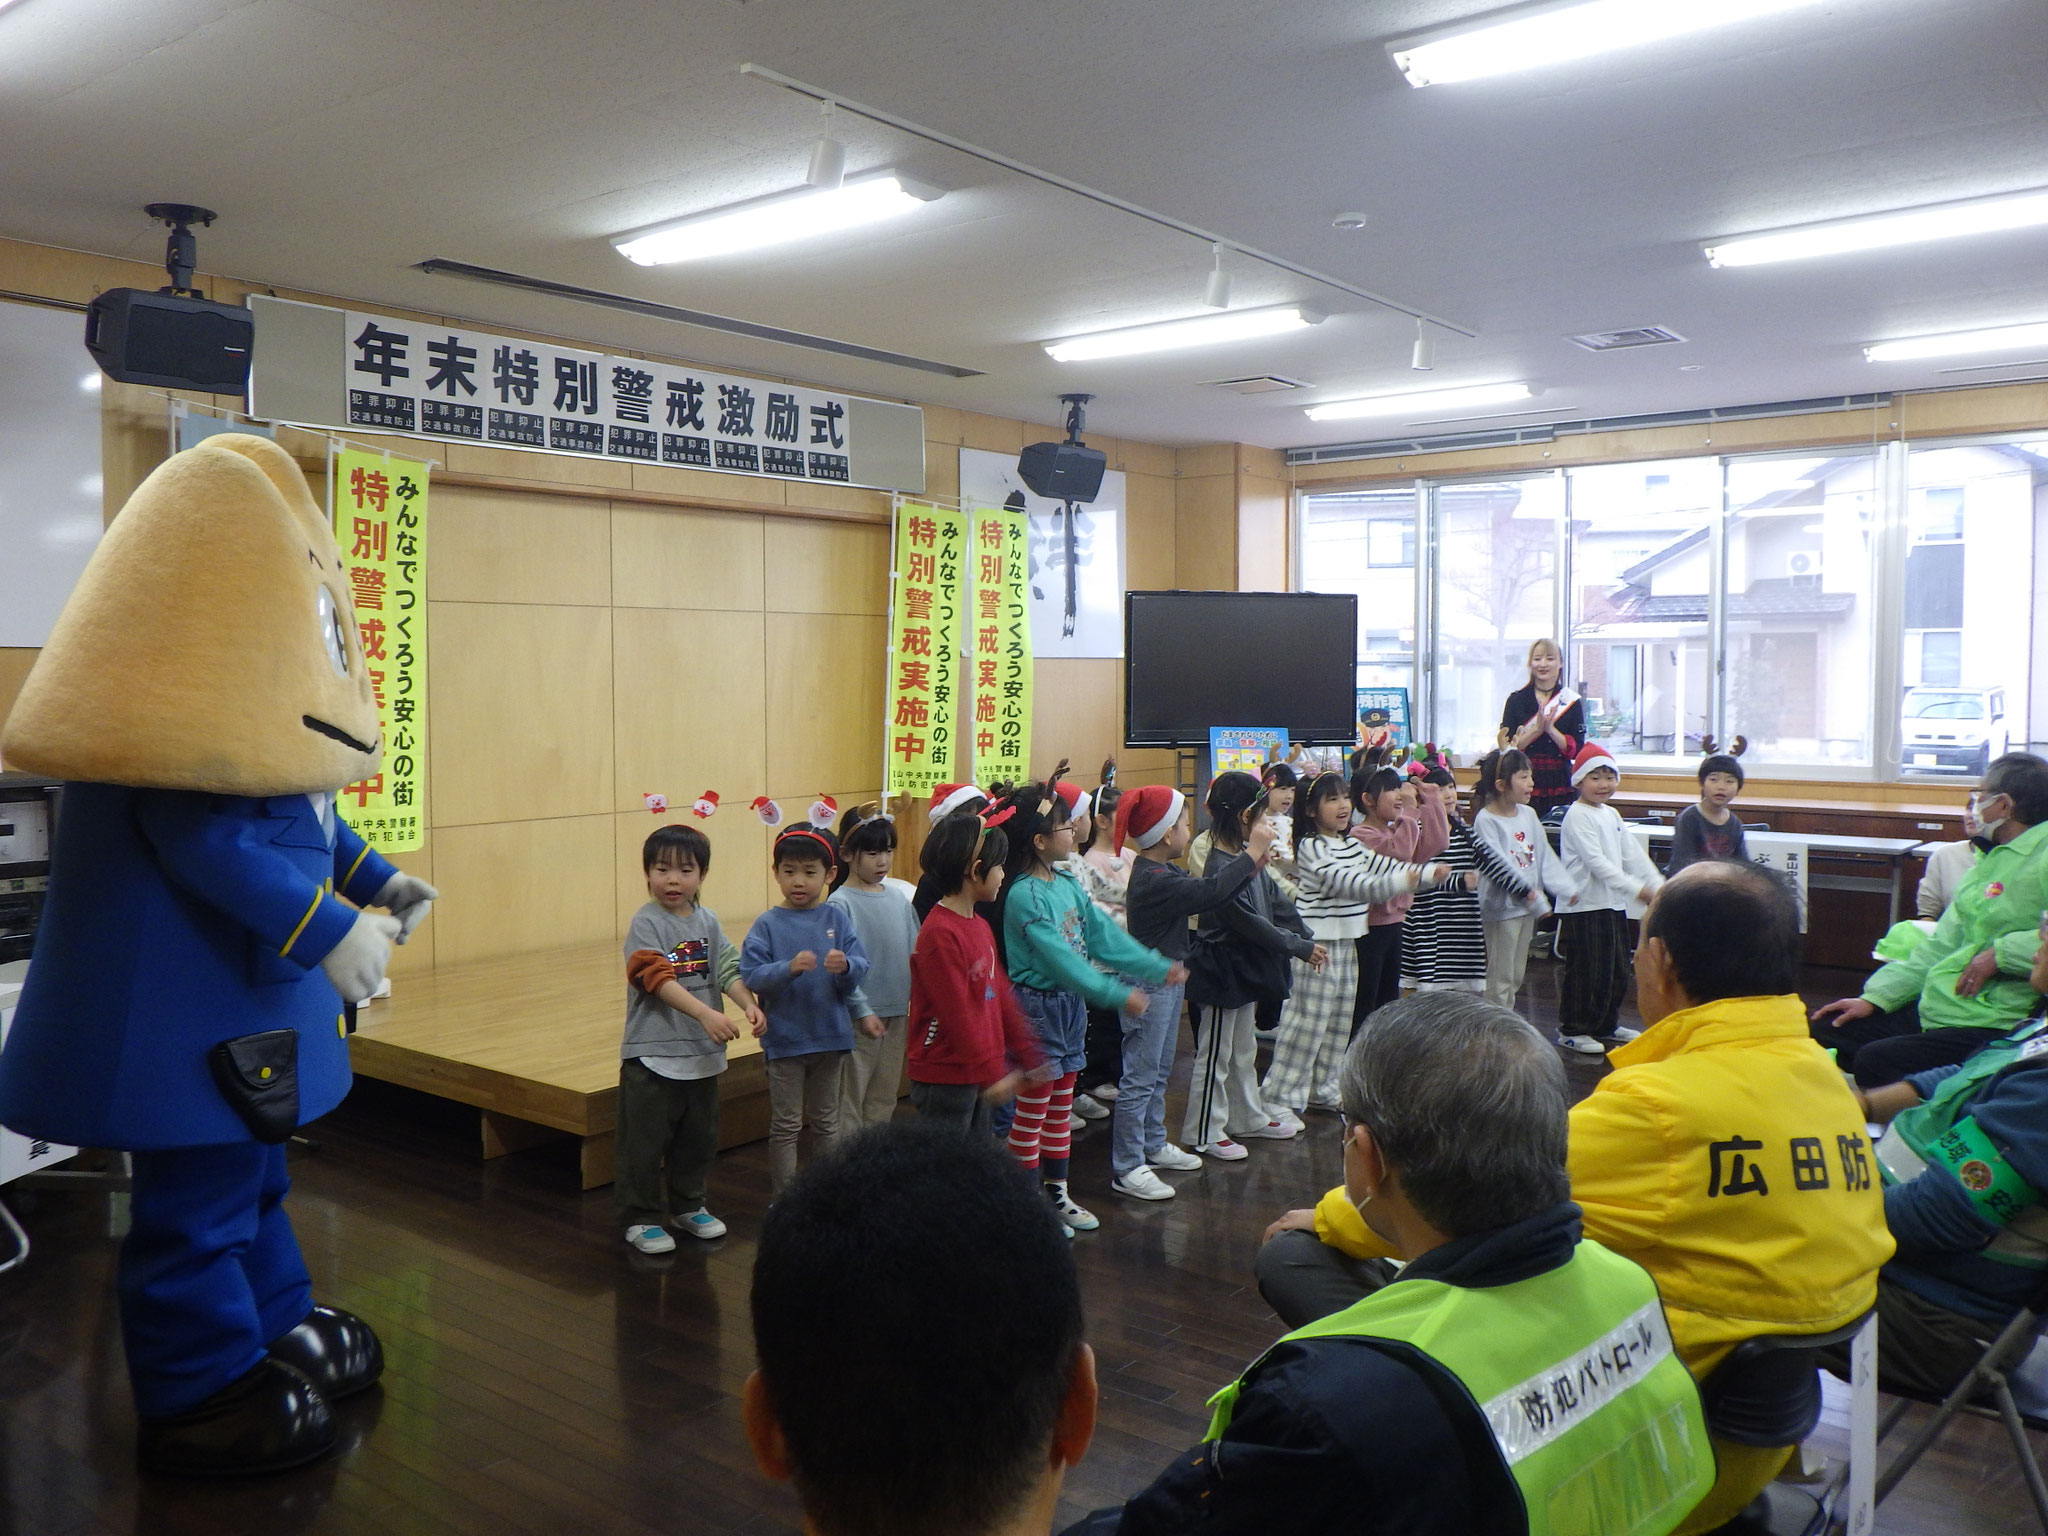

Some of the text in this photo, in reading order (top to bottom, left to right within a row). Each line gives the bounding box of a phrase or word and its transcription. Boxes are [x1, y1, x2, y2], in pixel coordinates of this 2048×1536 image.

[354, 321, 845, 450] 年末特別警戒激励式
[351, 392, 413, 412] 犯罪抑止
[351, 412, 413, 428] 交通事故防止
[423, 402, 481, 421] 犯罪抑止
[490, 411, 542, 429] 犯罪抑止
[423, 420, 480, 436] 交通事故防止
[489, 428, 543, 444] 交通事故防止
[551, 420, 603, 437] 犯罪抑止
[609, 428, 656, 444] 犯罪抑止
[551, 436, 602, 451] 交通事故防止
[609, 443, 657, 459] 交通事故防止
[664, 435, 709, 451] 犯罪抑止
[715, 442, 757, 457] 犯罪抑止
[664, 451, 710, 465] 交通事故防止
[763, 448, 803, 462] 犯罪抑止
[809, 455, 847, 467] 犯罪抑止
[343, 467, 389, 808] 特別警戒中
[393, 475, 420, 808] みんなでつくろう安心の街
[894, 516, 937, 762] 特別警戒実施中
[931, 522, 959, 765] みんなでつくろう安心の街
[976, 519, 1004, 757] 特別警戒実施中
[1000, 523, 1024, 758] みんなでつくろう安心の街
[345, 817, 416, 829] 山中央警察署
[1708, 1132, 1870, 1198] 広田防
[1520, 1322, 1652, 1432] 防犯パトロール
